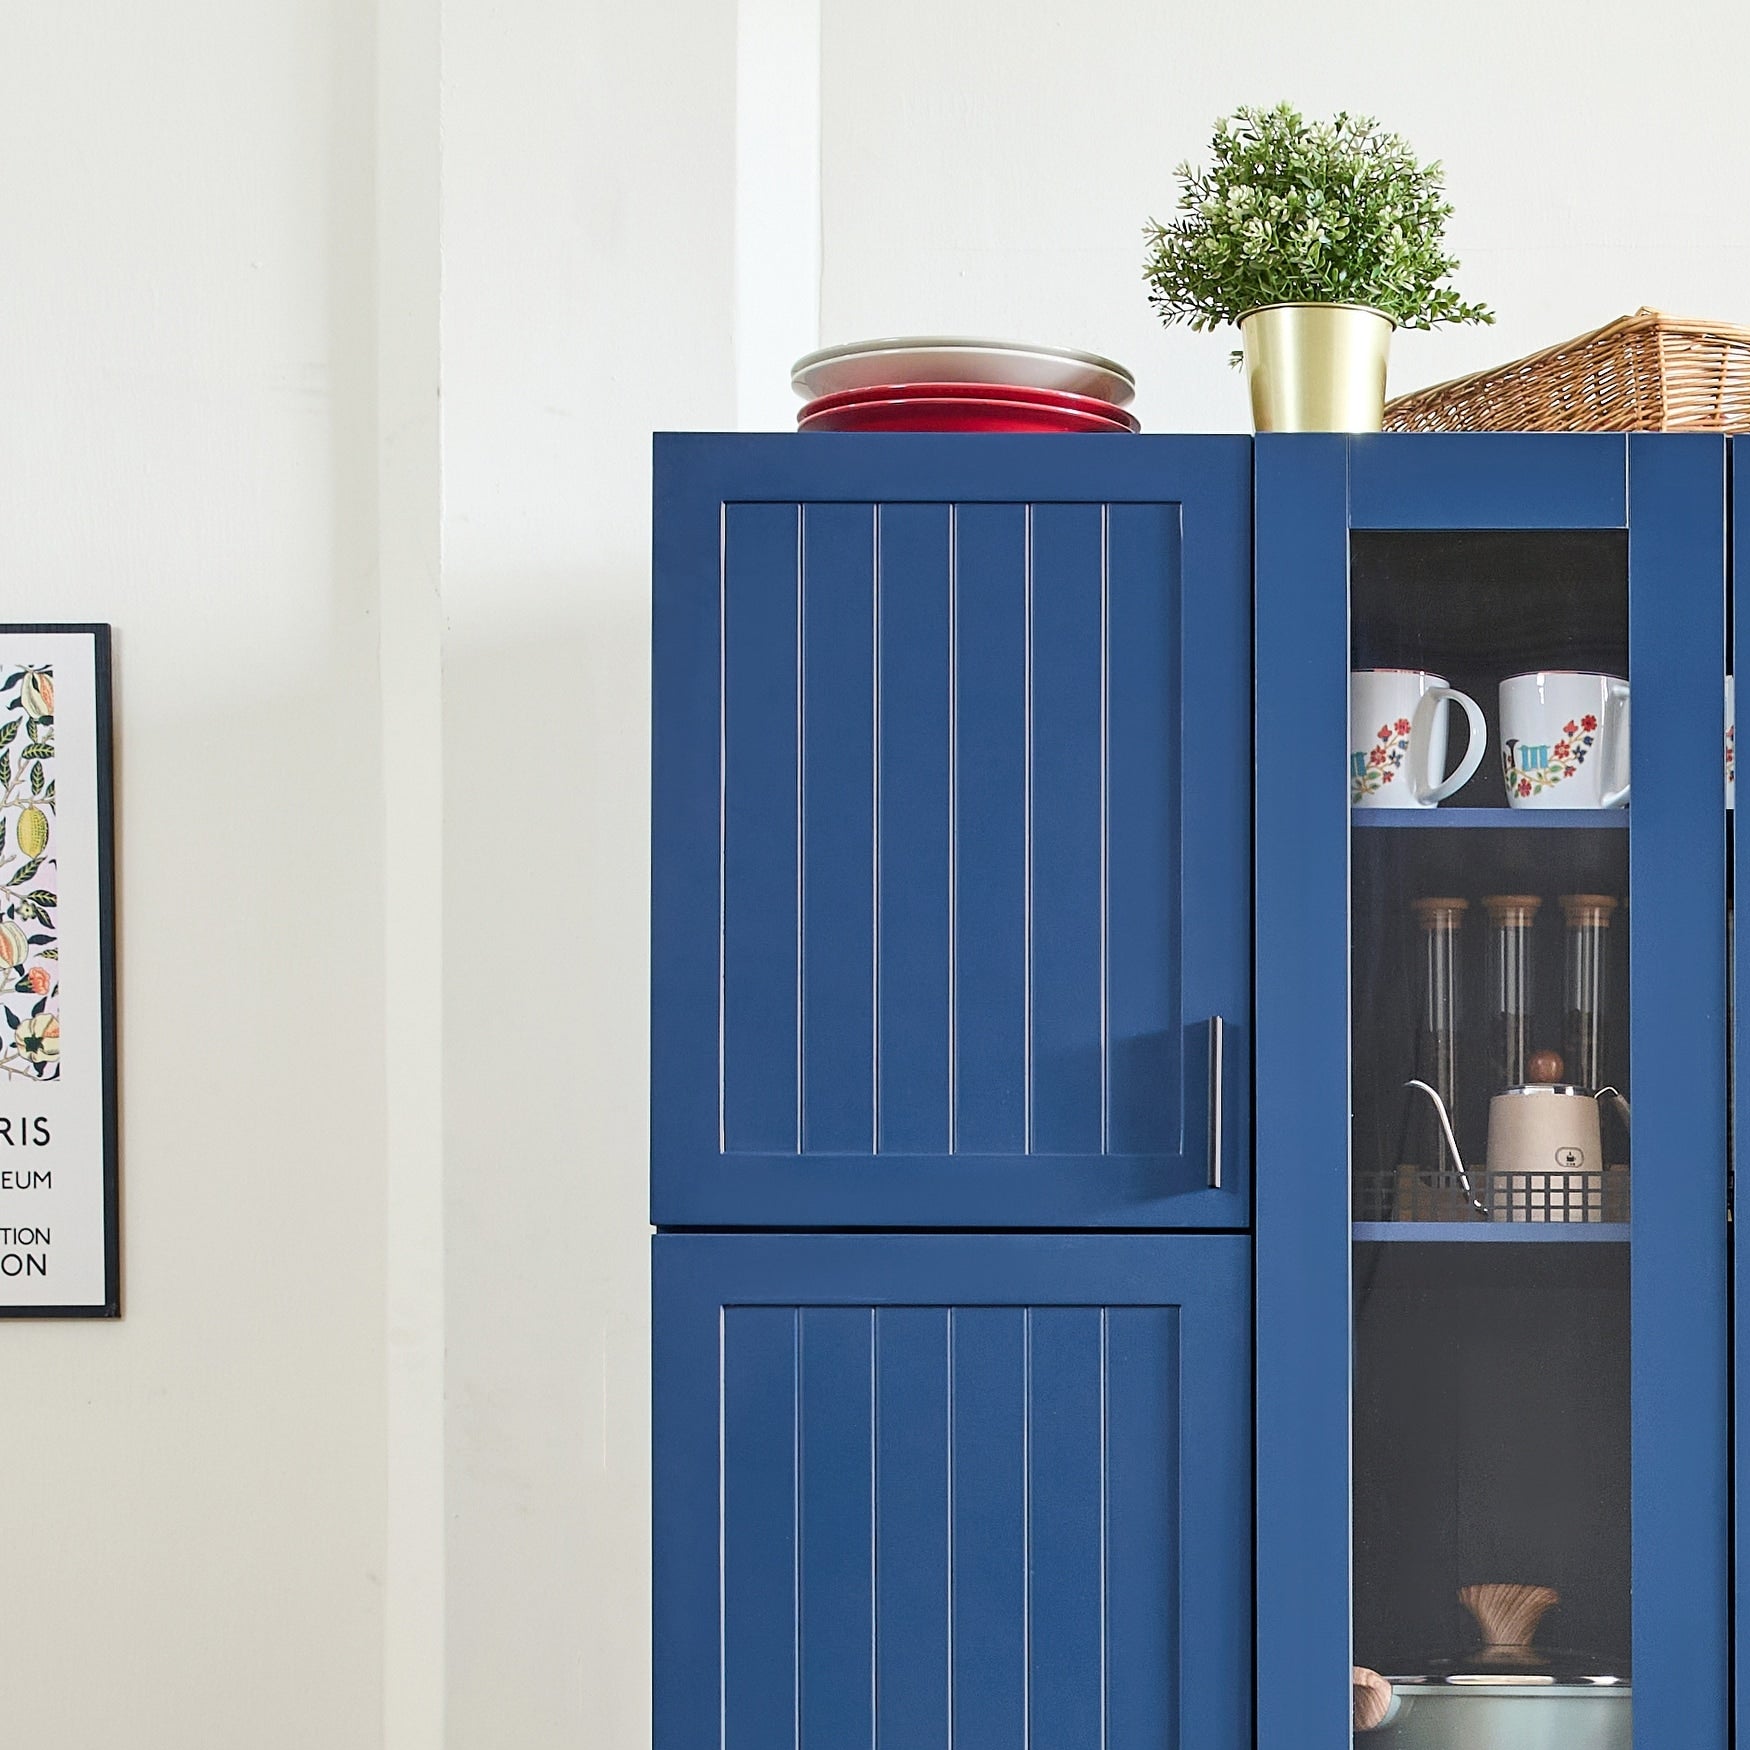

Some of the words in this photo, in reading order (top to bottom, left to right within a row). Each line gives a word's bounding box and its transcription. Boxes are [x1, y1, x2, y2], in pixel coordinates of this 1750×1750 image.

[2, 1171, 52, 1189] EUM
[0, 1228, 50, 1245] TION
[1, 1254, 46, 1276] ON
